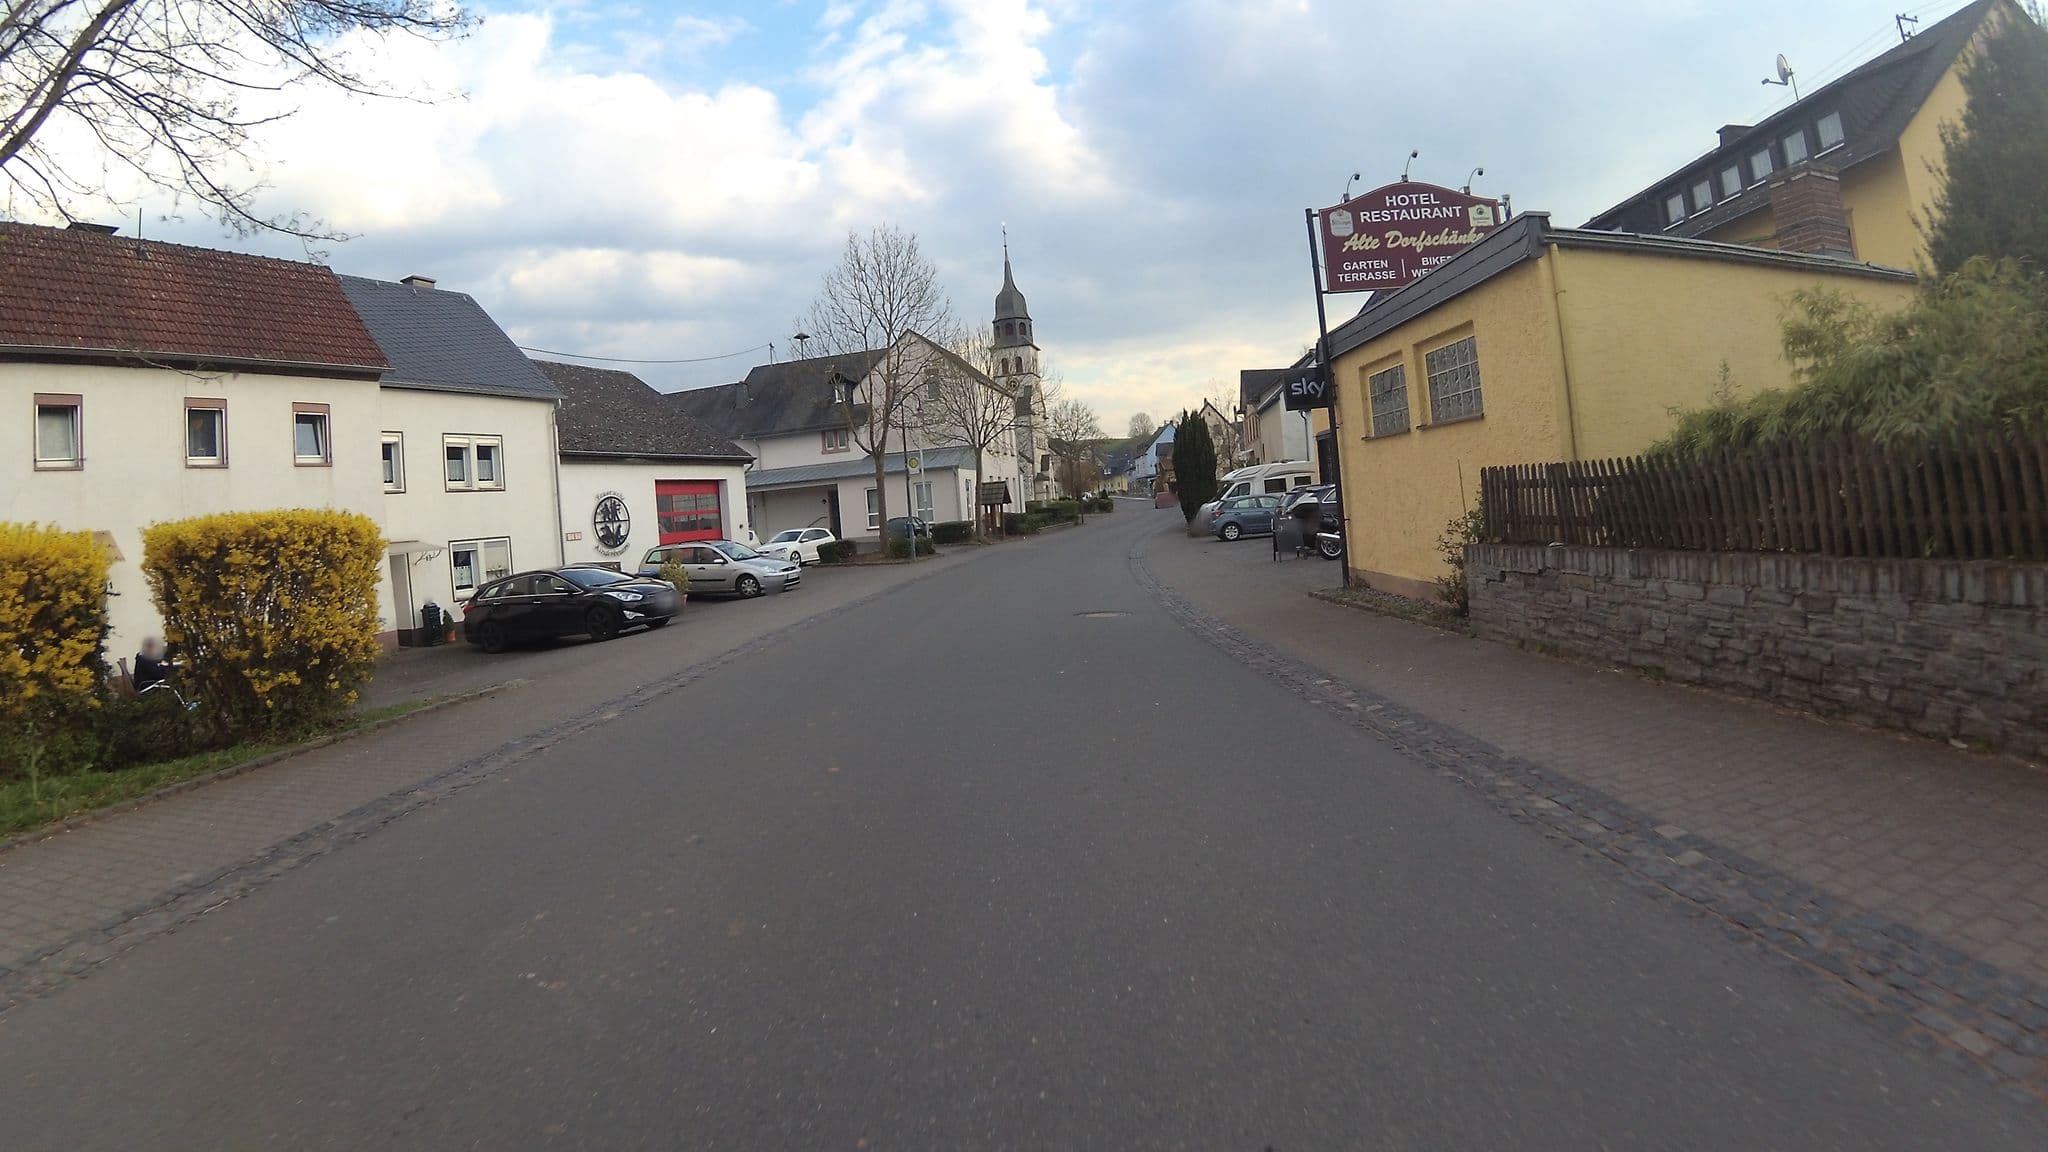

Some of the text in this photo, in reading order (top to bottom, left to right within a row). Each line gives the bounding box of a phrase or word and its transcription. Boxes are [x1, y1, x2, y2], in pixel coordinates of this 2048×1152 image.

[1385, 193, 1440, 207] HOTEL
[1360, 206, 1462, 223] RESTAURANT
[1342, 227, 1484, 253] Alte Dorfschänke
[1343, 260, 1388, 271] GARTEN
[1337, 270, 1396, 283] TERRASSE
[1291, 377, 1325, 398] sky
